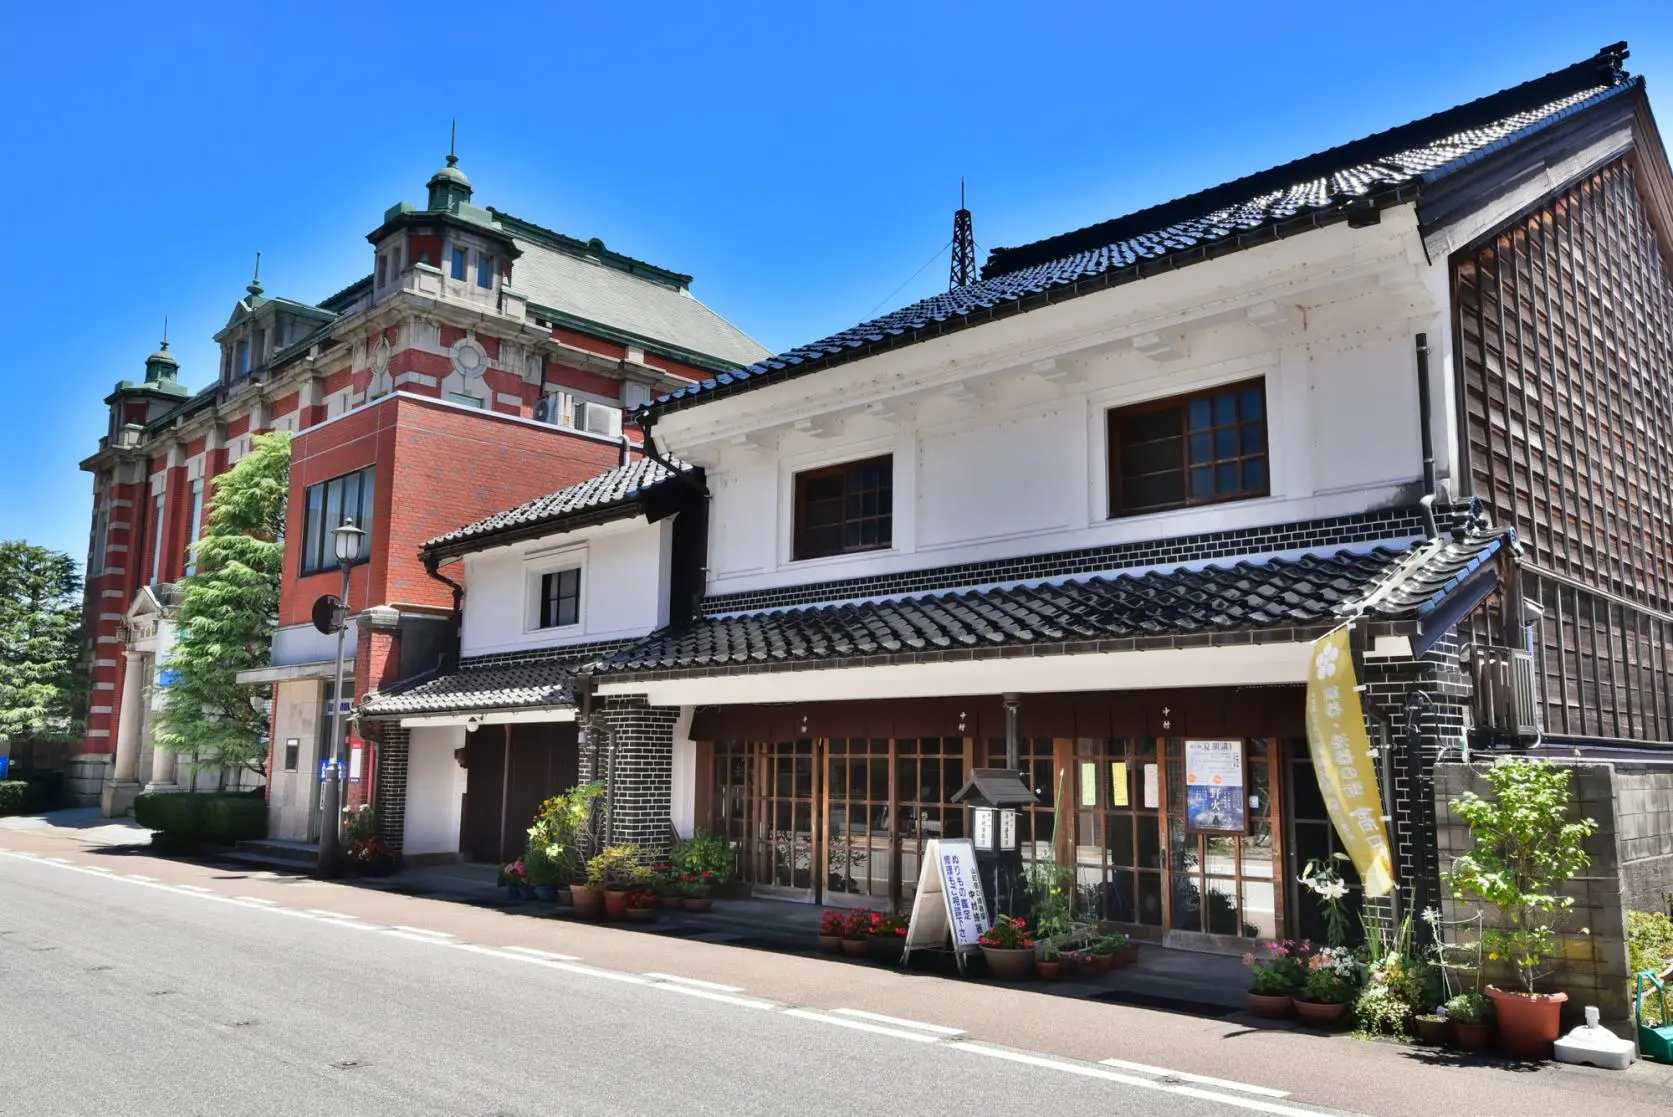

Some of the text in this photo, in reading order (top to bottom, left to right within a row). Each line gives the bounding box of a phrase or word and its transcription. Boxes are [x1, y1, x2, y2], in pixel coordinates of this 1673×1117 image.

[951, 854, 972, 920] ぬりもの鑑定
